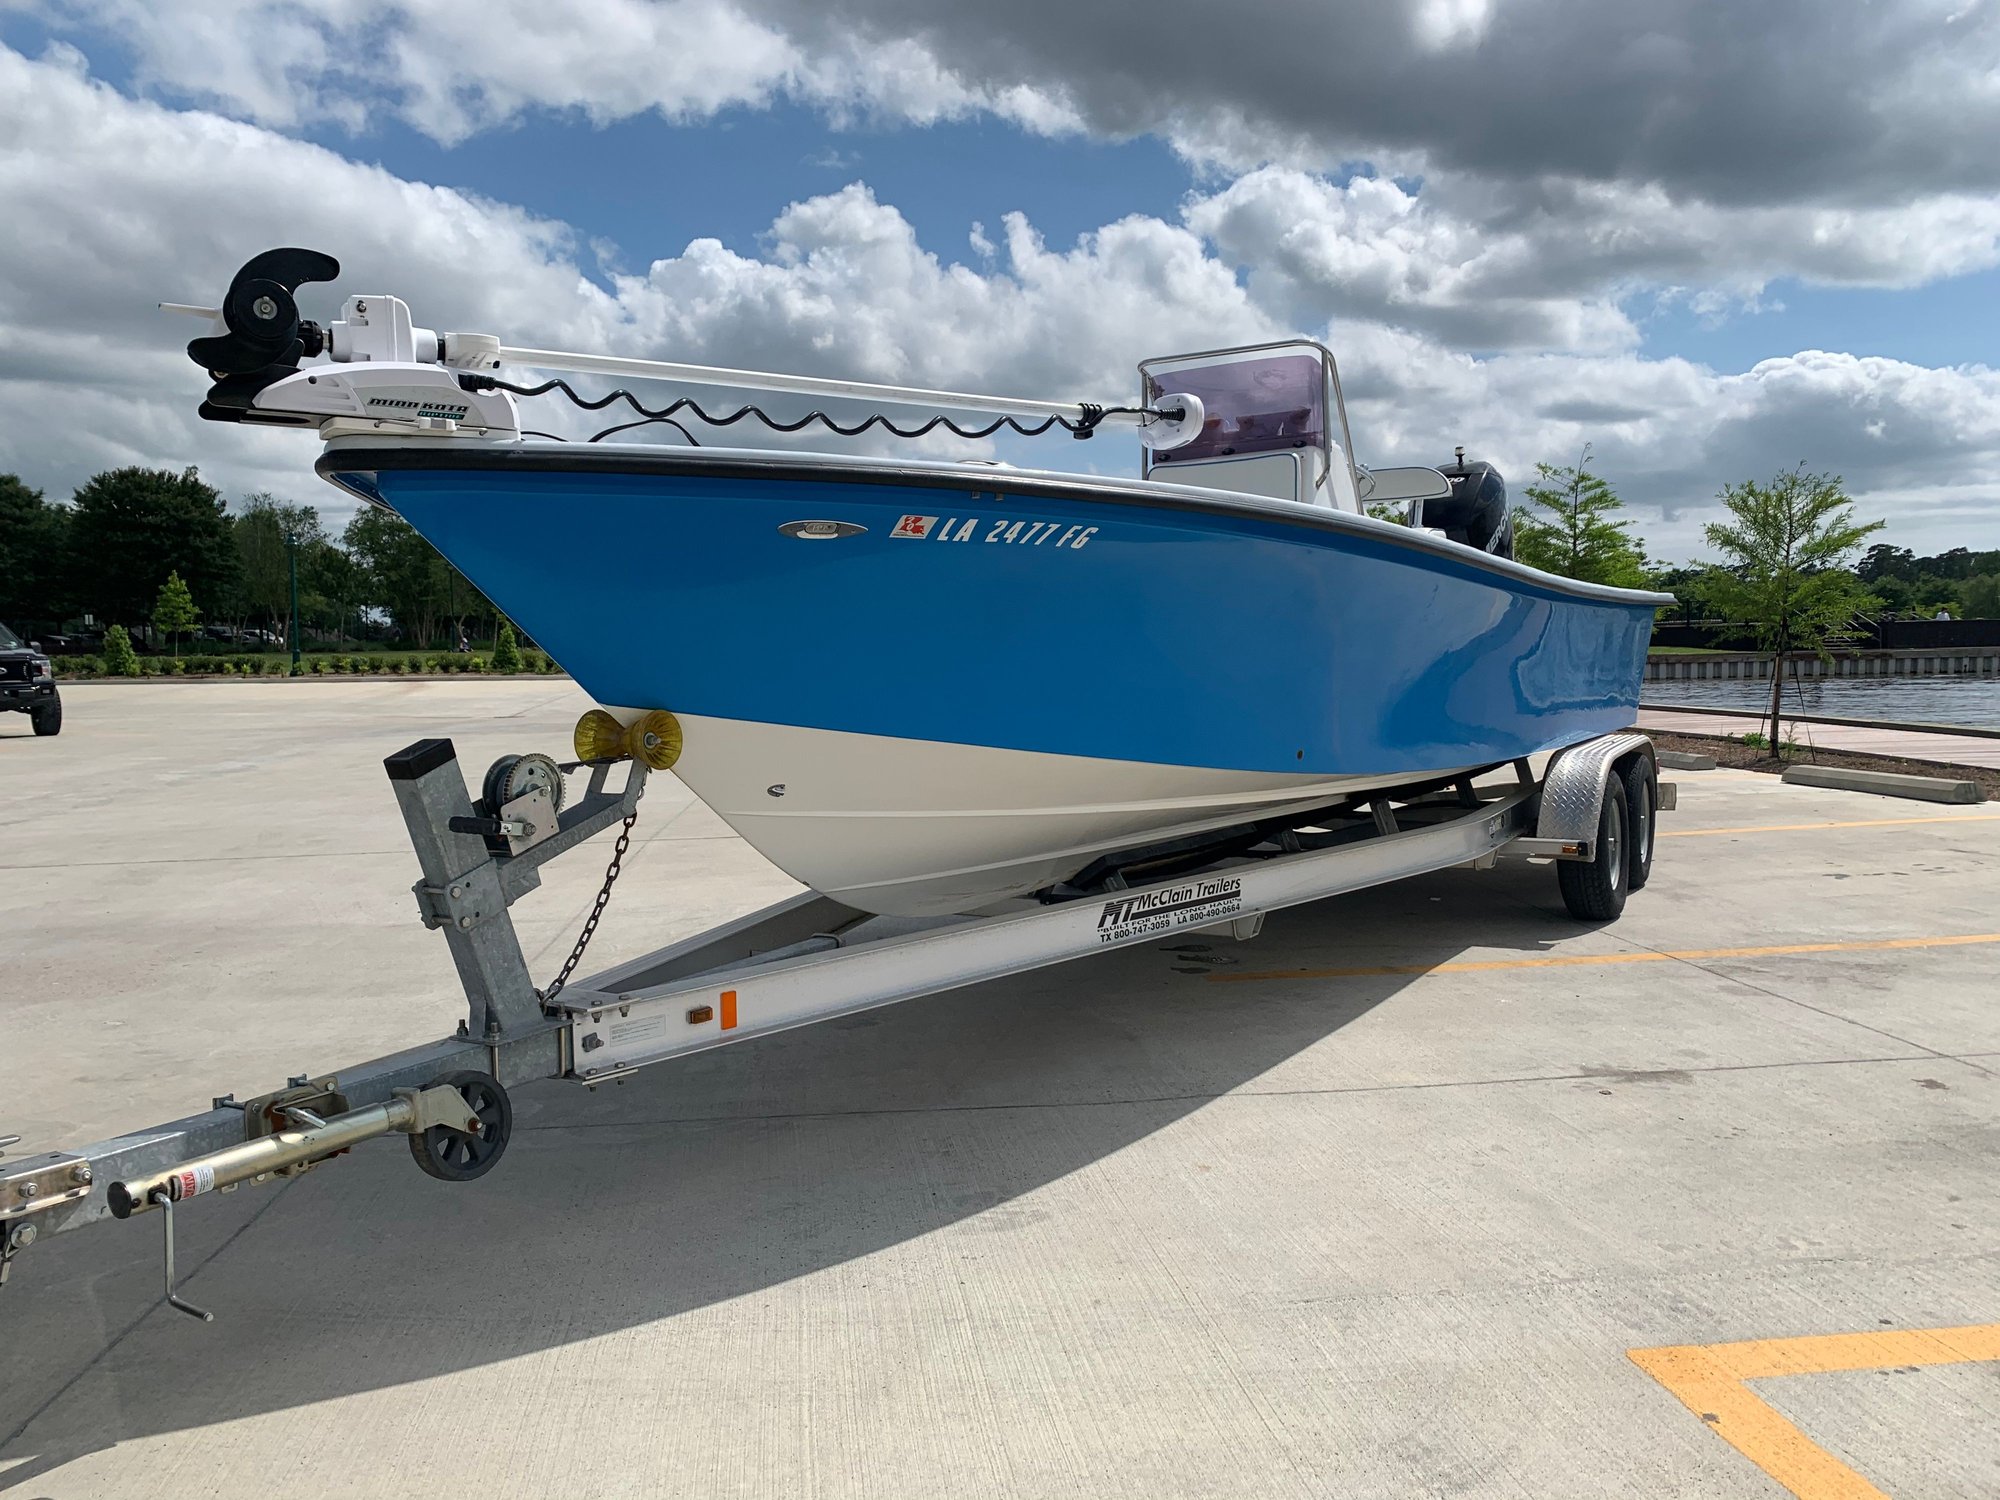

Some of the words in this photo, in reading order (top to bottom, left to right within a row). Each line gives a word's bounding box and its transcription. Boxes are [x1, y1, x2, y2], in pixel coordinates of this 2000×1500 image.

[936, 517, 979, 542] LA
[985, 520, 1061, 546] 2477
[1055, 525, 1099, 549] FG
[1137, 886, 1192, 911] McClain
[1197, 878, 1241, 898] Trailers
[1100, 933, 1112, 943] TX
[1114, 919, 1170, 939] 800-747-3059
[1177, 915, 1188, 924] LA
[1189, 903, 1240, 921] 800-490-0664
[1131, 917, 1151, 926] FOR
[1153, 912, 1171, 921] THE
[1174, 905, 1206, 917] LONG
